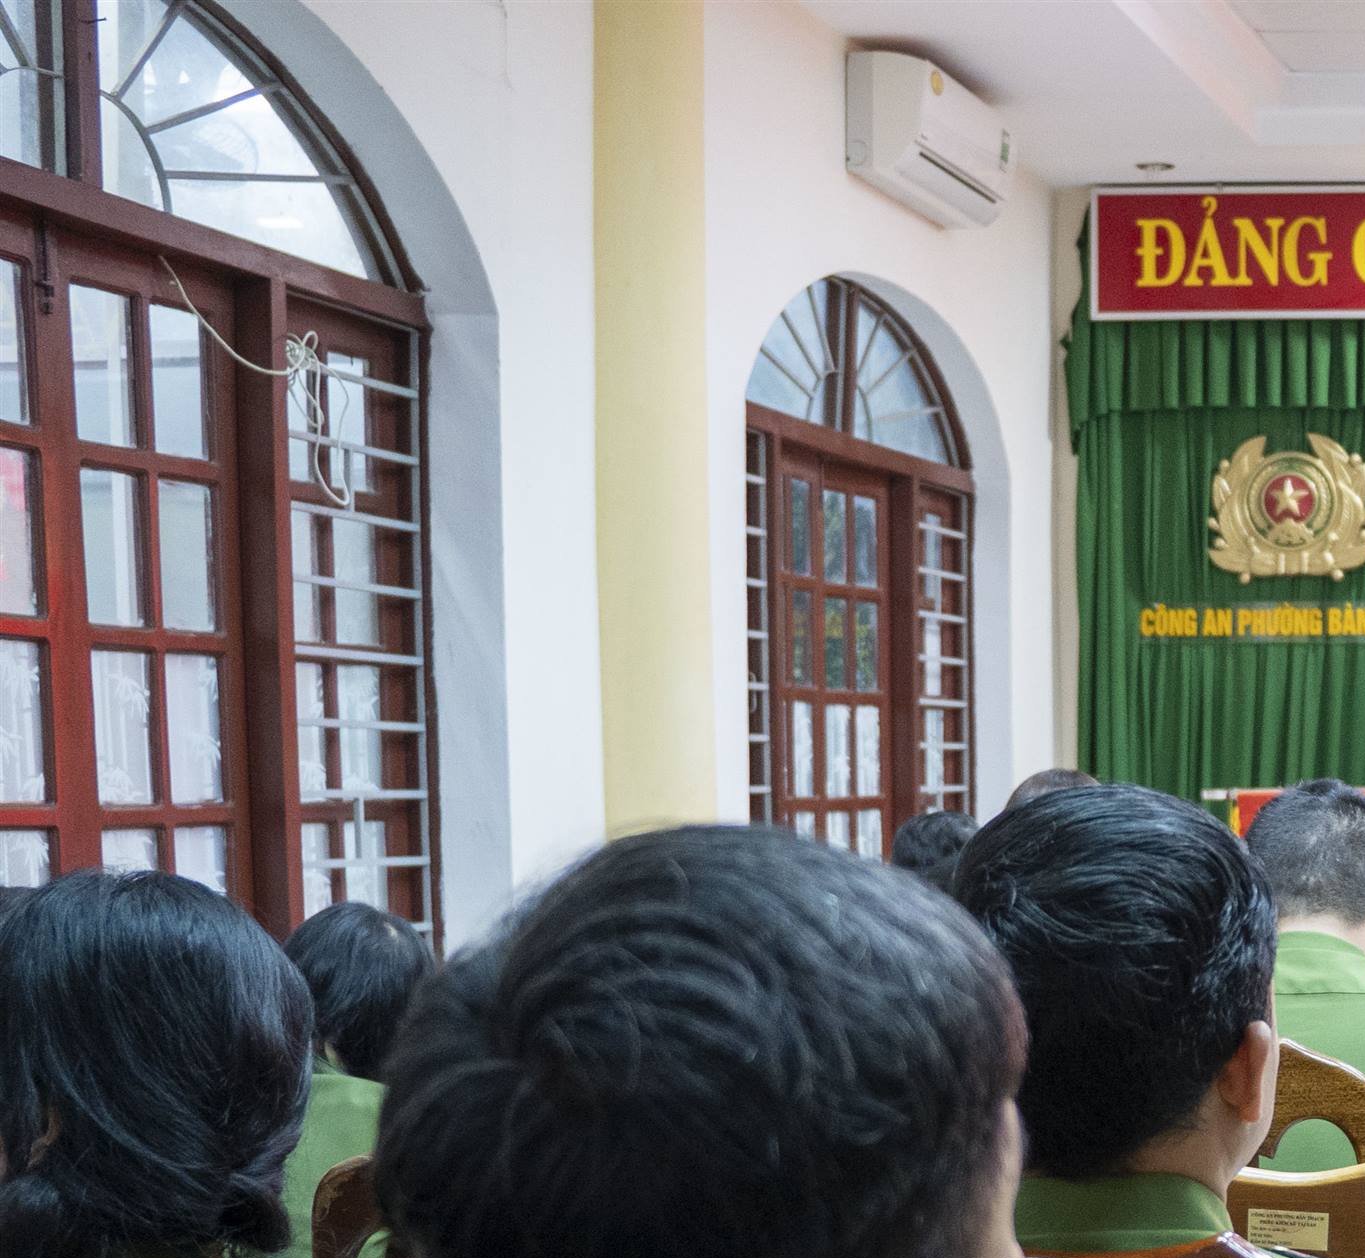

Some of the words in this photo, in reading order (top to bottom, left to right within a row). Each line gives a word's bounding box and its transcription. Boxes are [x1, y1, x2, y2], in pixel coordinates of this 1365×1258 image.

[1135, 197, 1333, 287] ĐẢNG
[1140, 603, 1198, 637] CÔNG
[1203, 608, 1233, 637] AN
[1237, 602, 1323, 637] PHƯỜNG
